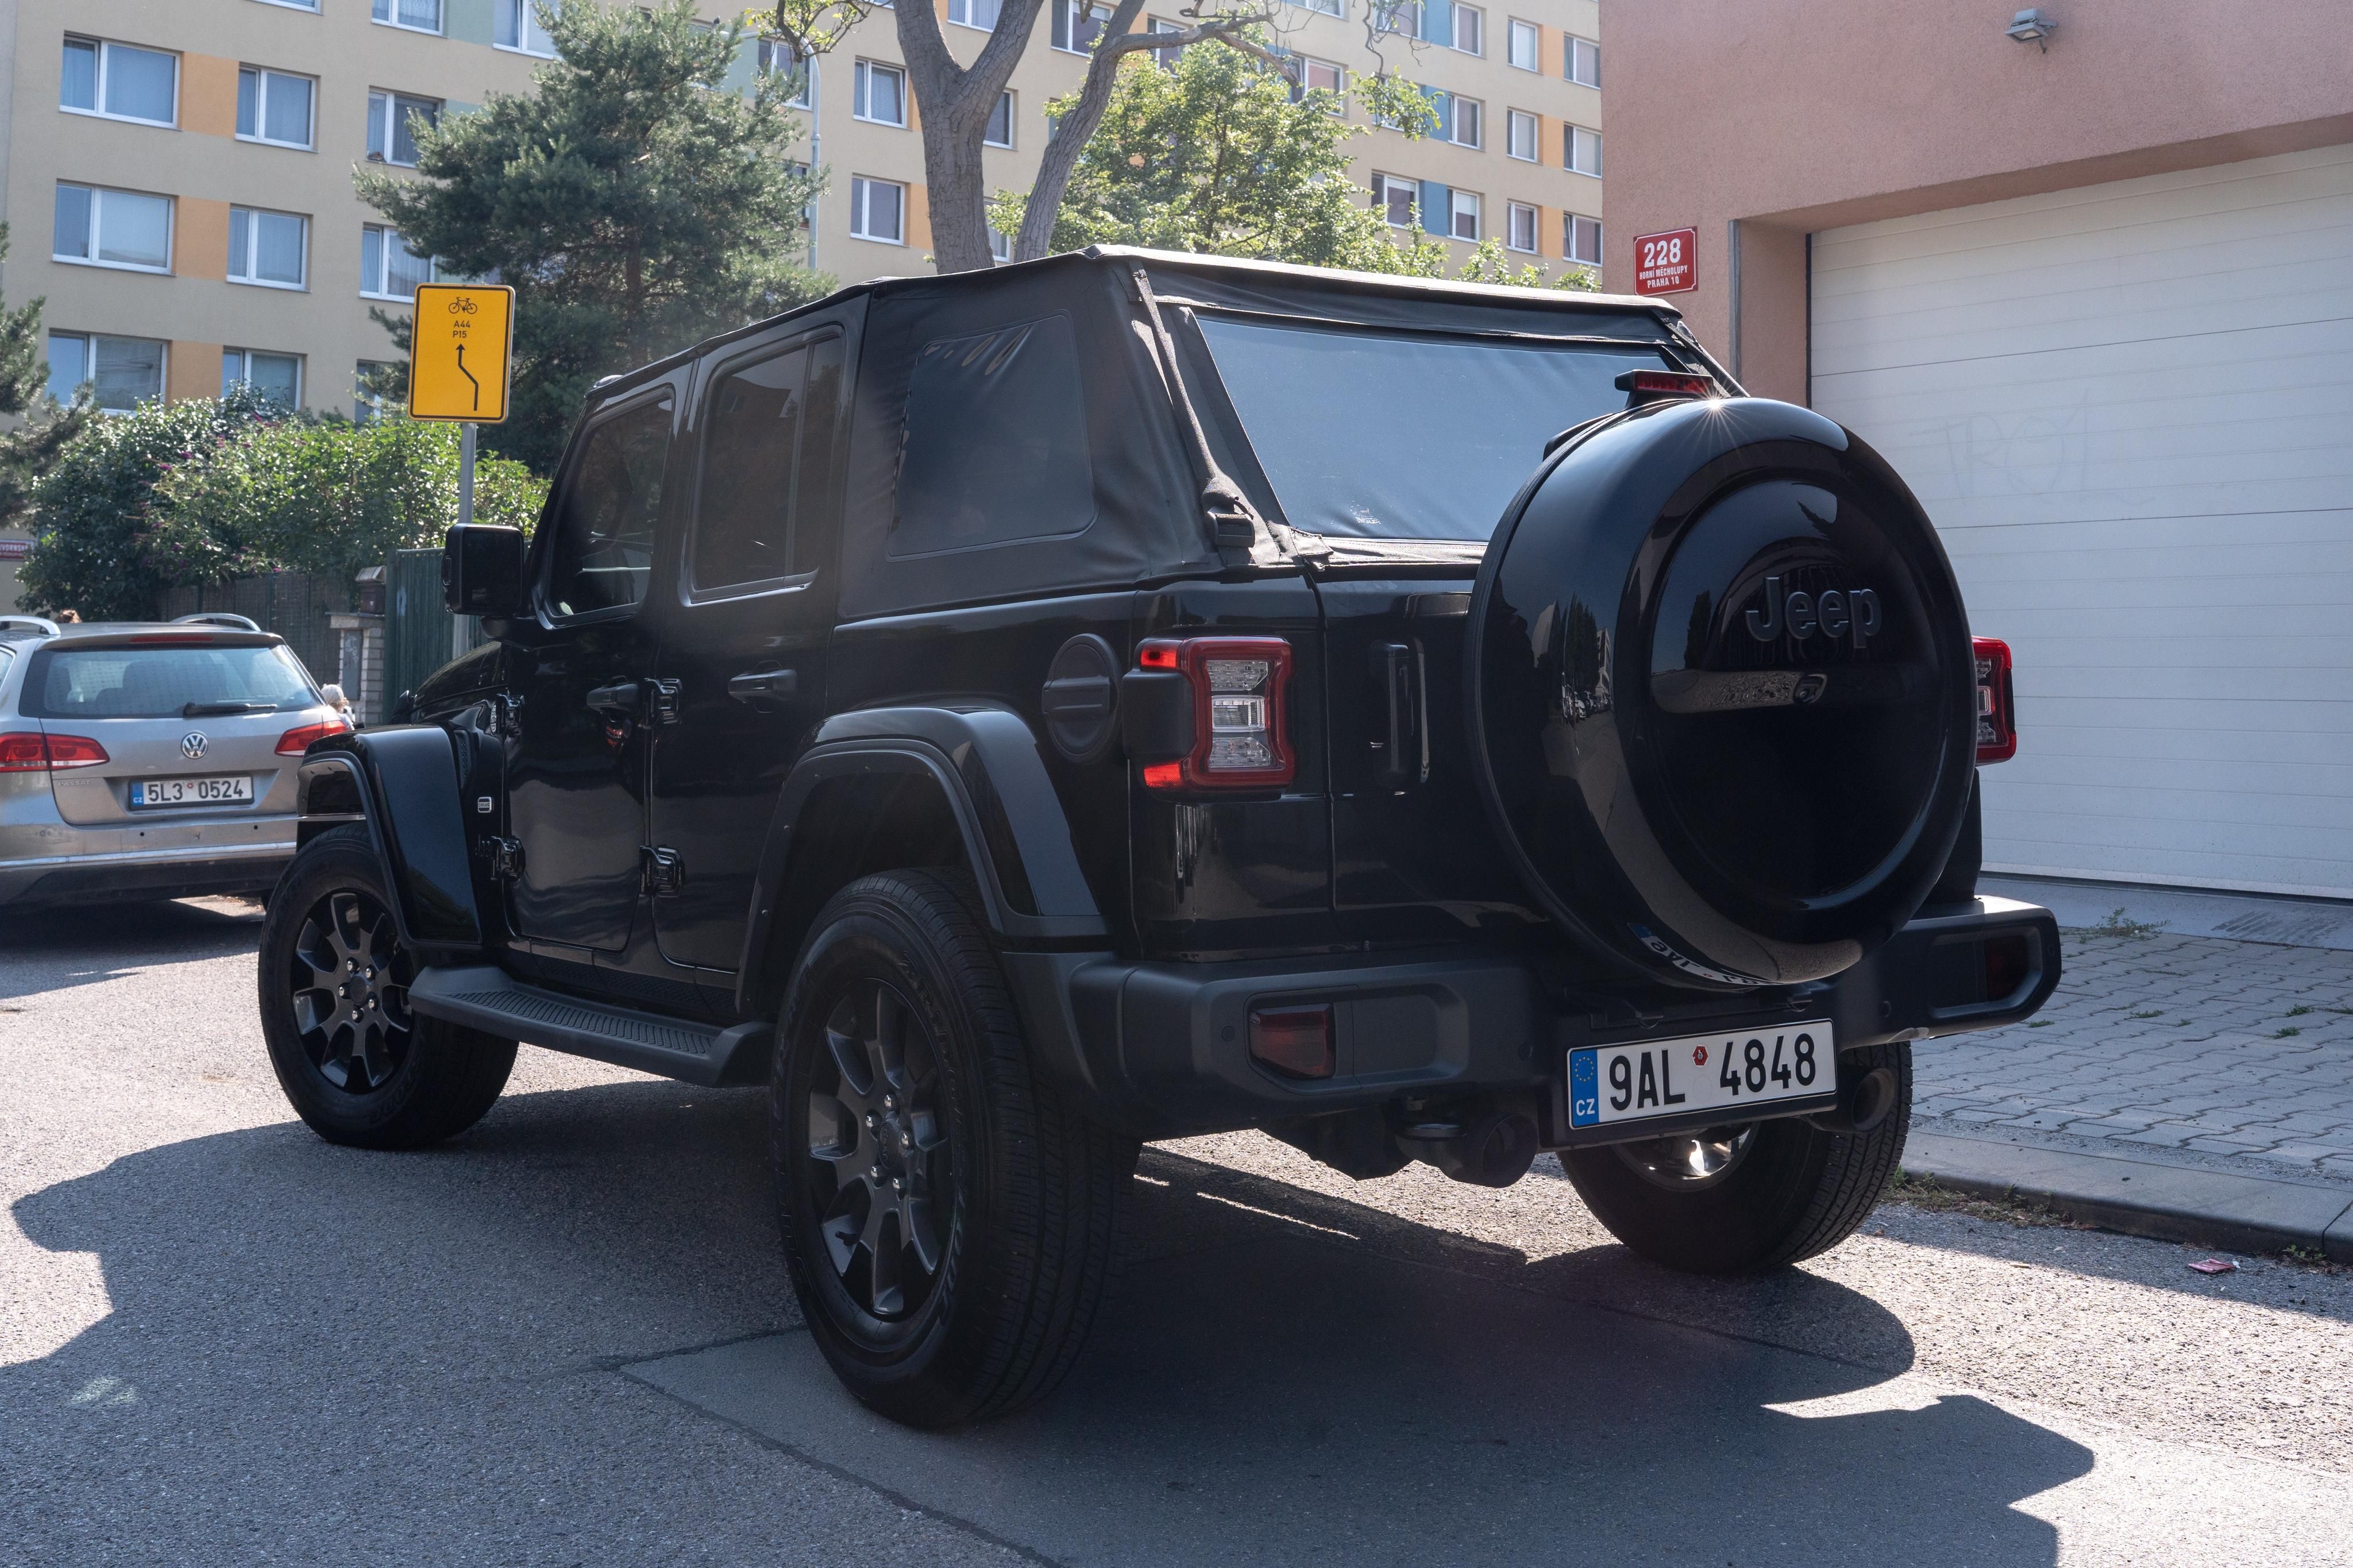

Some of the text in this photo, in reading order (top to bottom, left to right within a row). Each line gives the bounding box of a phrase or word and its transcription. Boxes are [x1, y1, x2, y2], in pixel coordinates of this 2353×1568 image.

[1644, 238, 1681, 268] 228
[1639, 265, 1688, 280] HORNÍ MĚCHOLUPY
[1647, 276, 1680, 288] PRAHA 10
[453, 330, 467, 338] P15
[1745, 576, 1882, 650] Jeep
[148, 779, 244, 802] 5L3 0524
[1609, 1033, 1816, 1111] 9AL 4848
[1576, 1098, 1595, 1117] CZ
